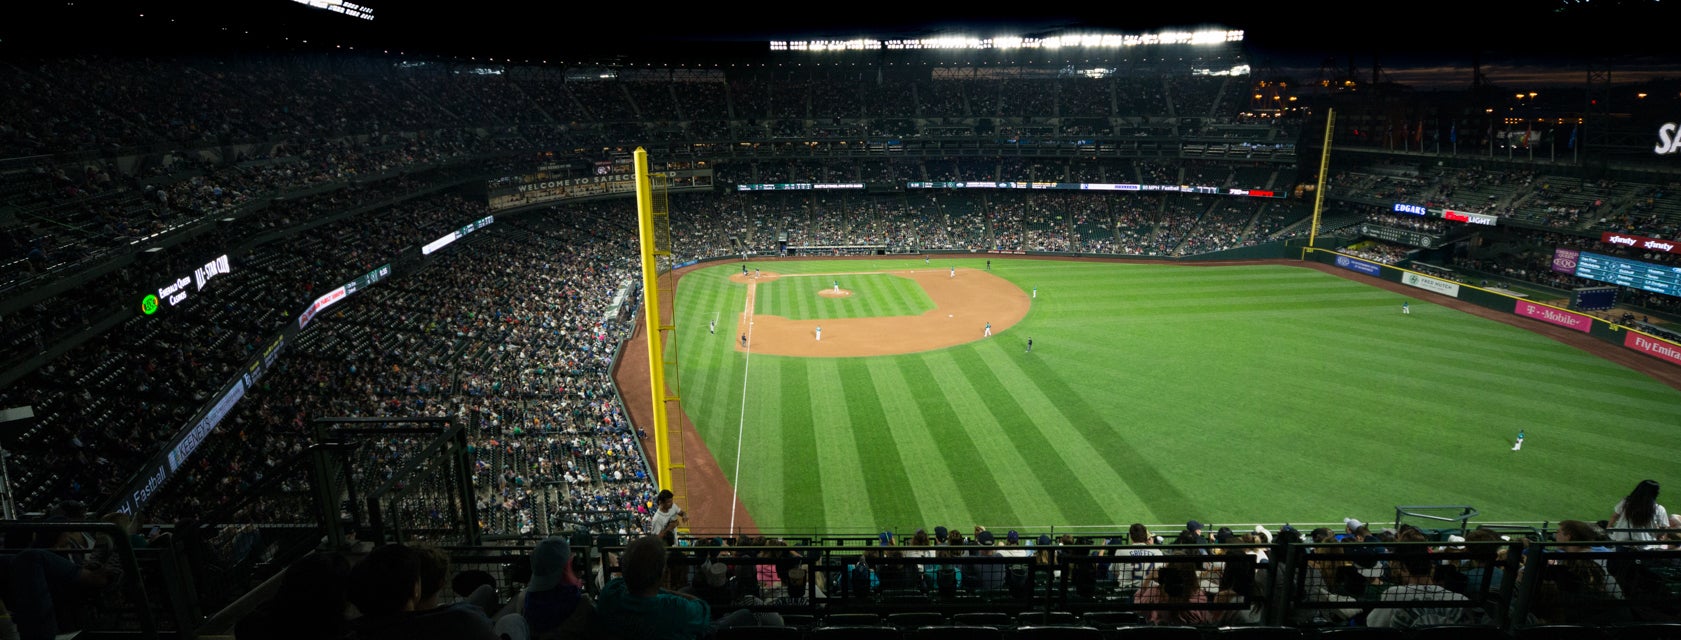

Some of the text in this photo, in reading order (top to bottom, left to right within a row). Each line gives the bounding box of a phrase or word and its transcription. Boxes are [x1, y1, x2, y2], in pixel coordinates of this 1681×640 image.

[518, 179, 570, 193] WELCOME
[573, 177, 589, 185] TO
[1469, 216, 1491, 225] LIGHT
[1609, 235, 1674, 252] xfinity xfinity
[1635, 337, 1652, 350] Fly
[133, 465, 167, 508] Fastball
